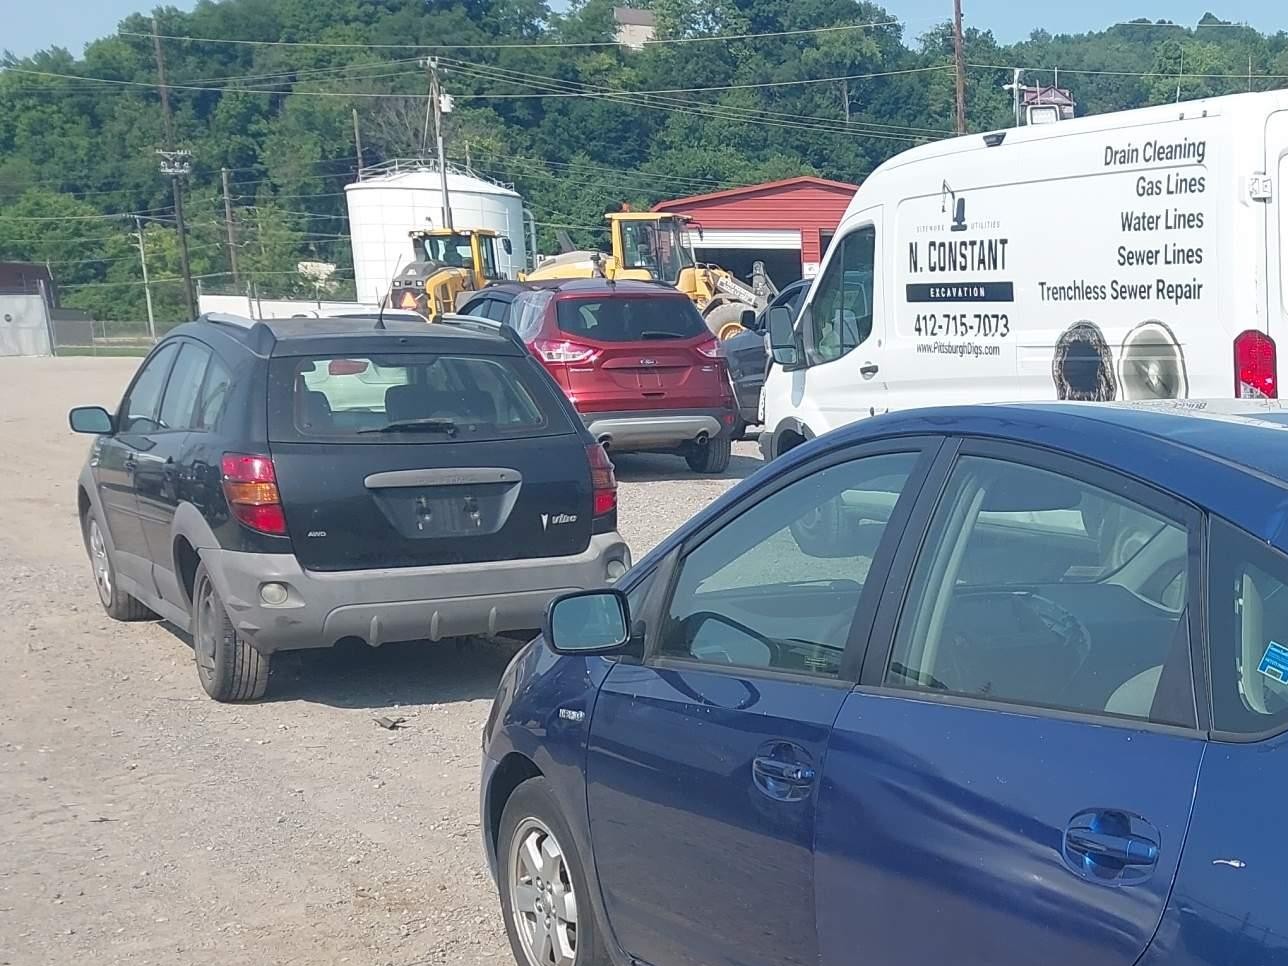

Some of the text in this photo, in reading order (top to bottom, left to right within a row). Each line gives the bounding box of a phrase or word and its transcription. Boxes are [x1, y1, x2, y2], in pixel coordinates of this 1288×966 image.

[1104, 137, 1206, 166] Drain Cleaning
[1136, 173, 1206, 197] Gas Lines
[970, 220, 1001, 230] UTILITIES
[1121, 208, 1204, 232] Water Lines
[909, 238, 1008, 273] N. CONSTANT
[1117, 243, 1203, 266] Sewer Lines
[930, 286, 985, 298] EXCAVATION
[1038, 278, 1203, 306] Trenchless Sewer Repair
[914, 313, 1010, 338] 412-715-7073
[916, 341, 1001, 358] www.PittsburghDigs.com
